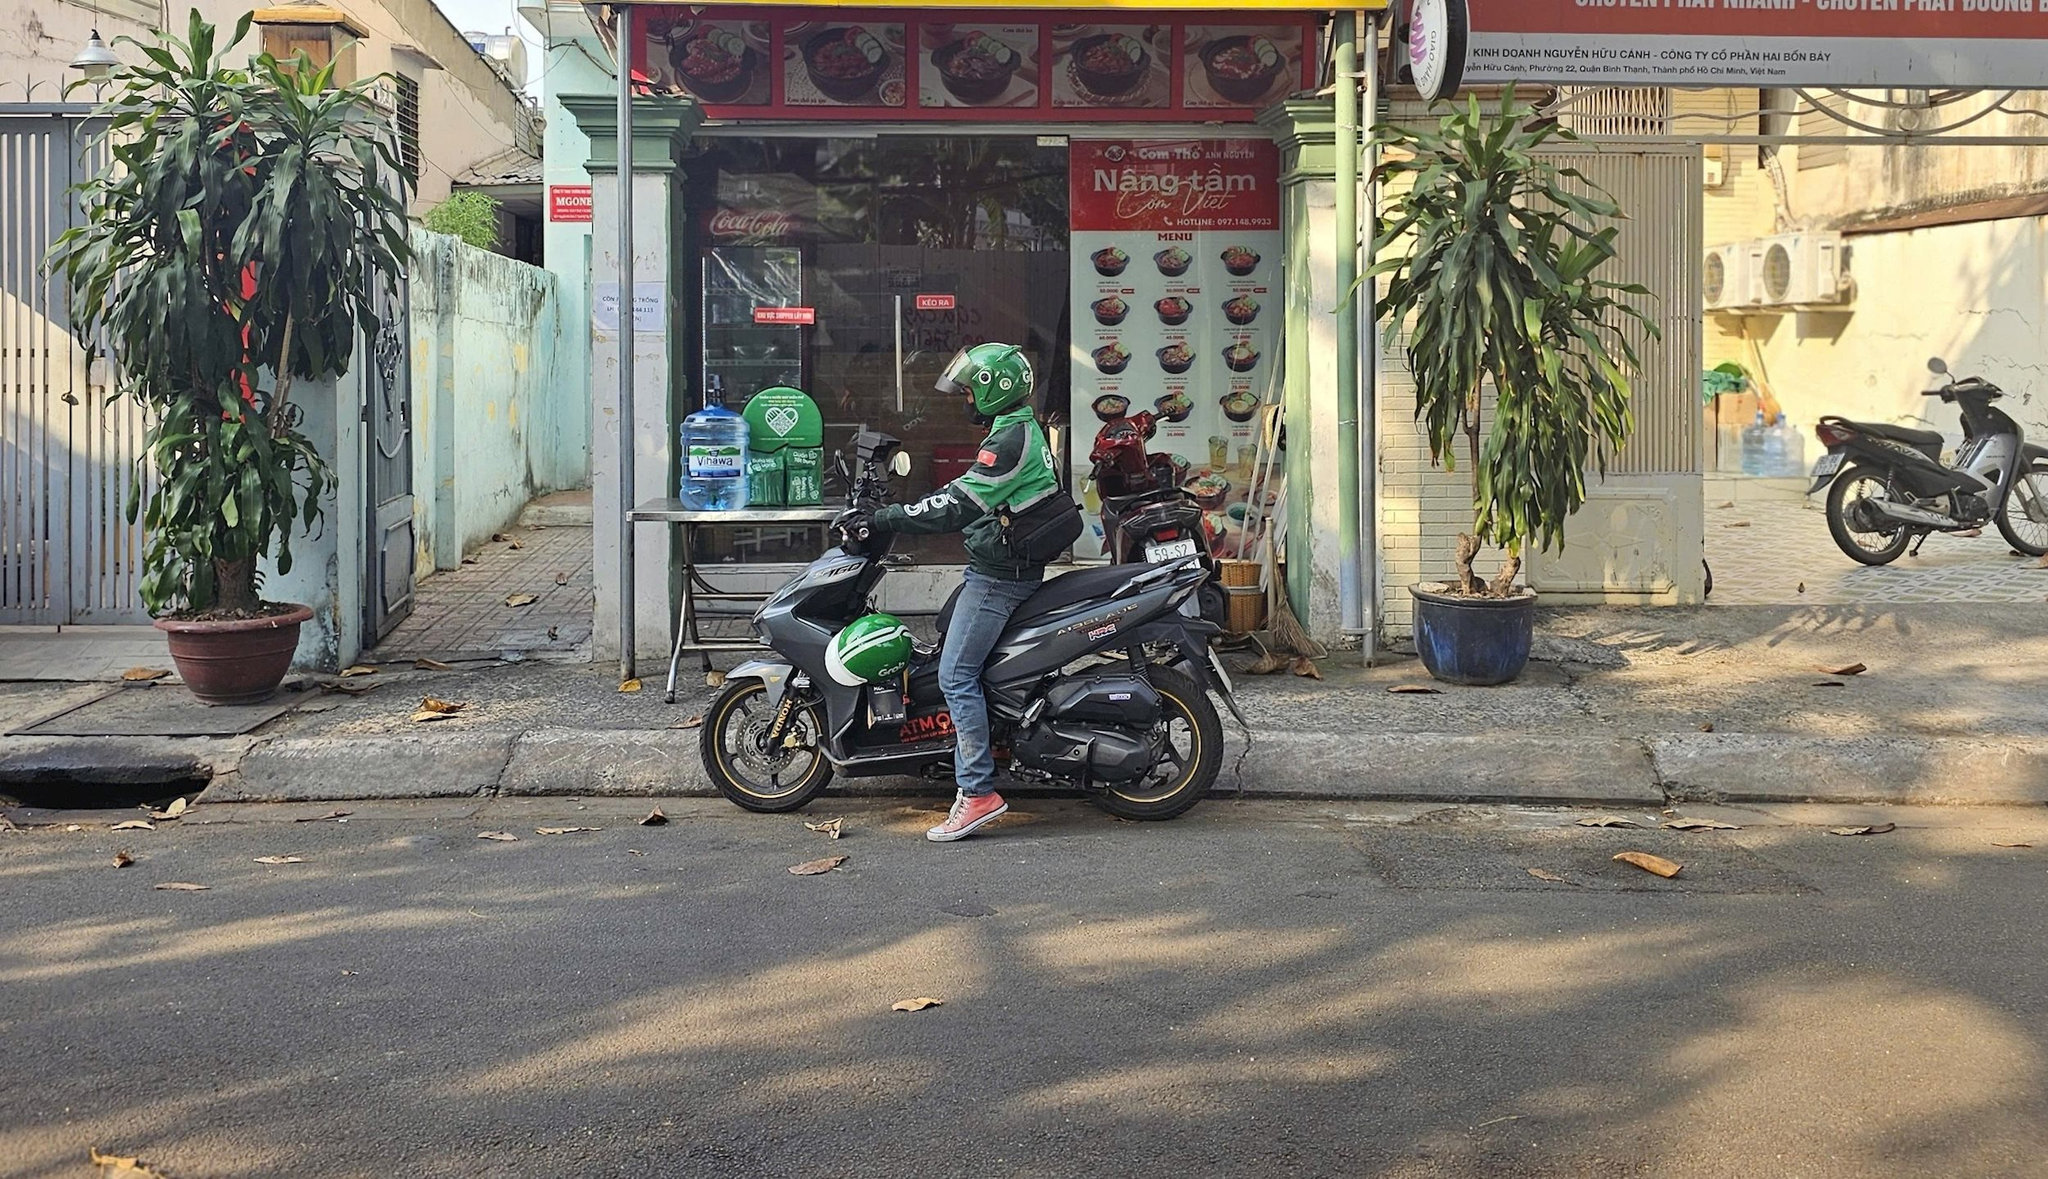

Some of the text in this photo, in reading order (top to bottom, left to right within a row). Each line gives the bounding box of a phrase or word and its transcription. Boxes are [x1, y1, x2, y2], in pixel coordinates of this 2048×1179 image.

[1429, 30, 1437, 60] GIAO
[1473, 48, 1499, 58] KINH
[1502, 48, 1541, 59] DOANH
[1544, 46, 1590, 59] NGUYỄN
[1592, 47, 1617, 59] HỮU
[1661, 50, 1692, 60] CÔNG
[1695, 51, 1709, 60] TY
[1763, 52, 1781, 61] HAI
[1565, 65, 1578, 73] 22,
[1726, 67, 1748, 75] Minh,
[1094, 163, 1256, 196] Nâng tầm
[1177, 218, 1215, 226] HOTLINE:
[1158, 233, 1193, 241] MENU
[922, 298, 937, 306] KÉO
[697, 456, 733, 466] Vihawa
[878, 662, 905, 677] Grab
[771, 698, 793, 738] HONDA
